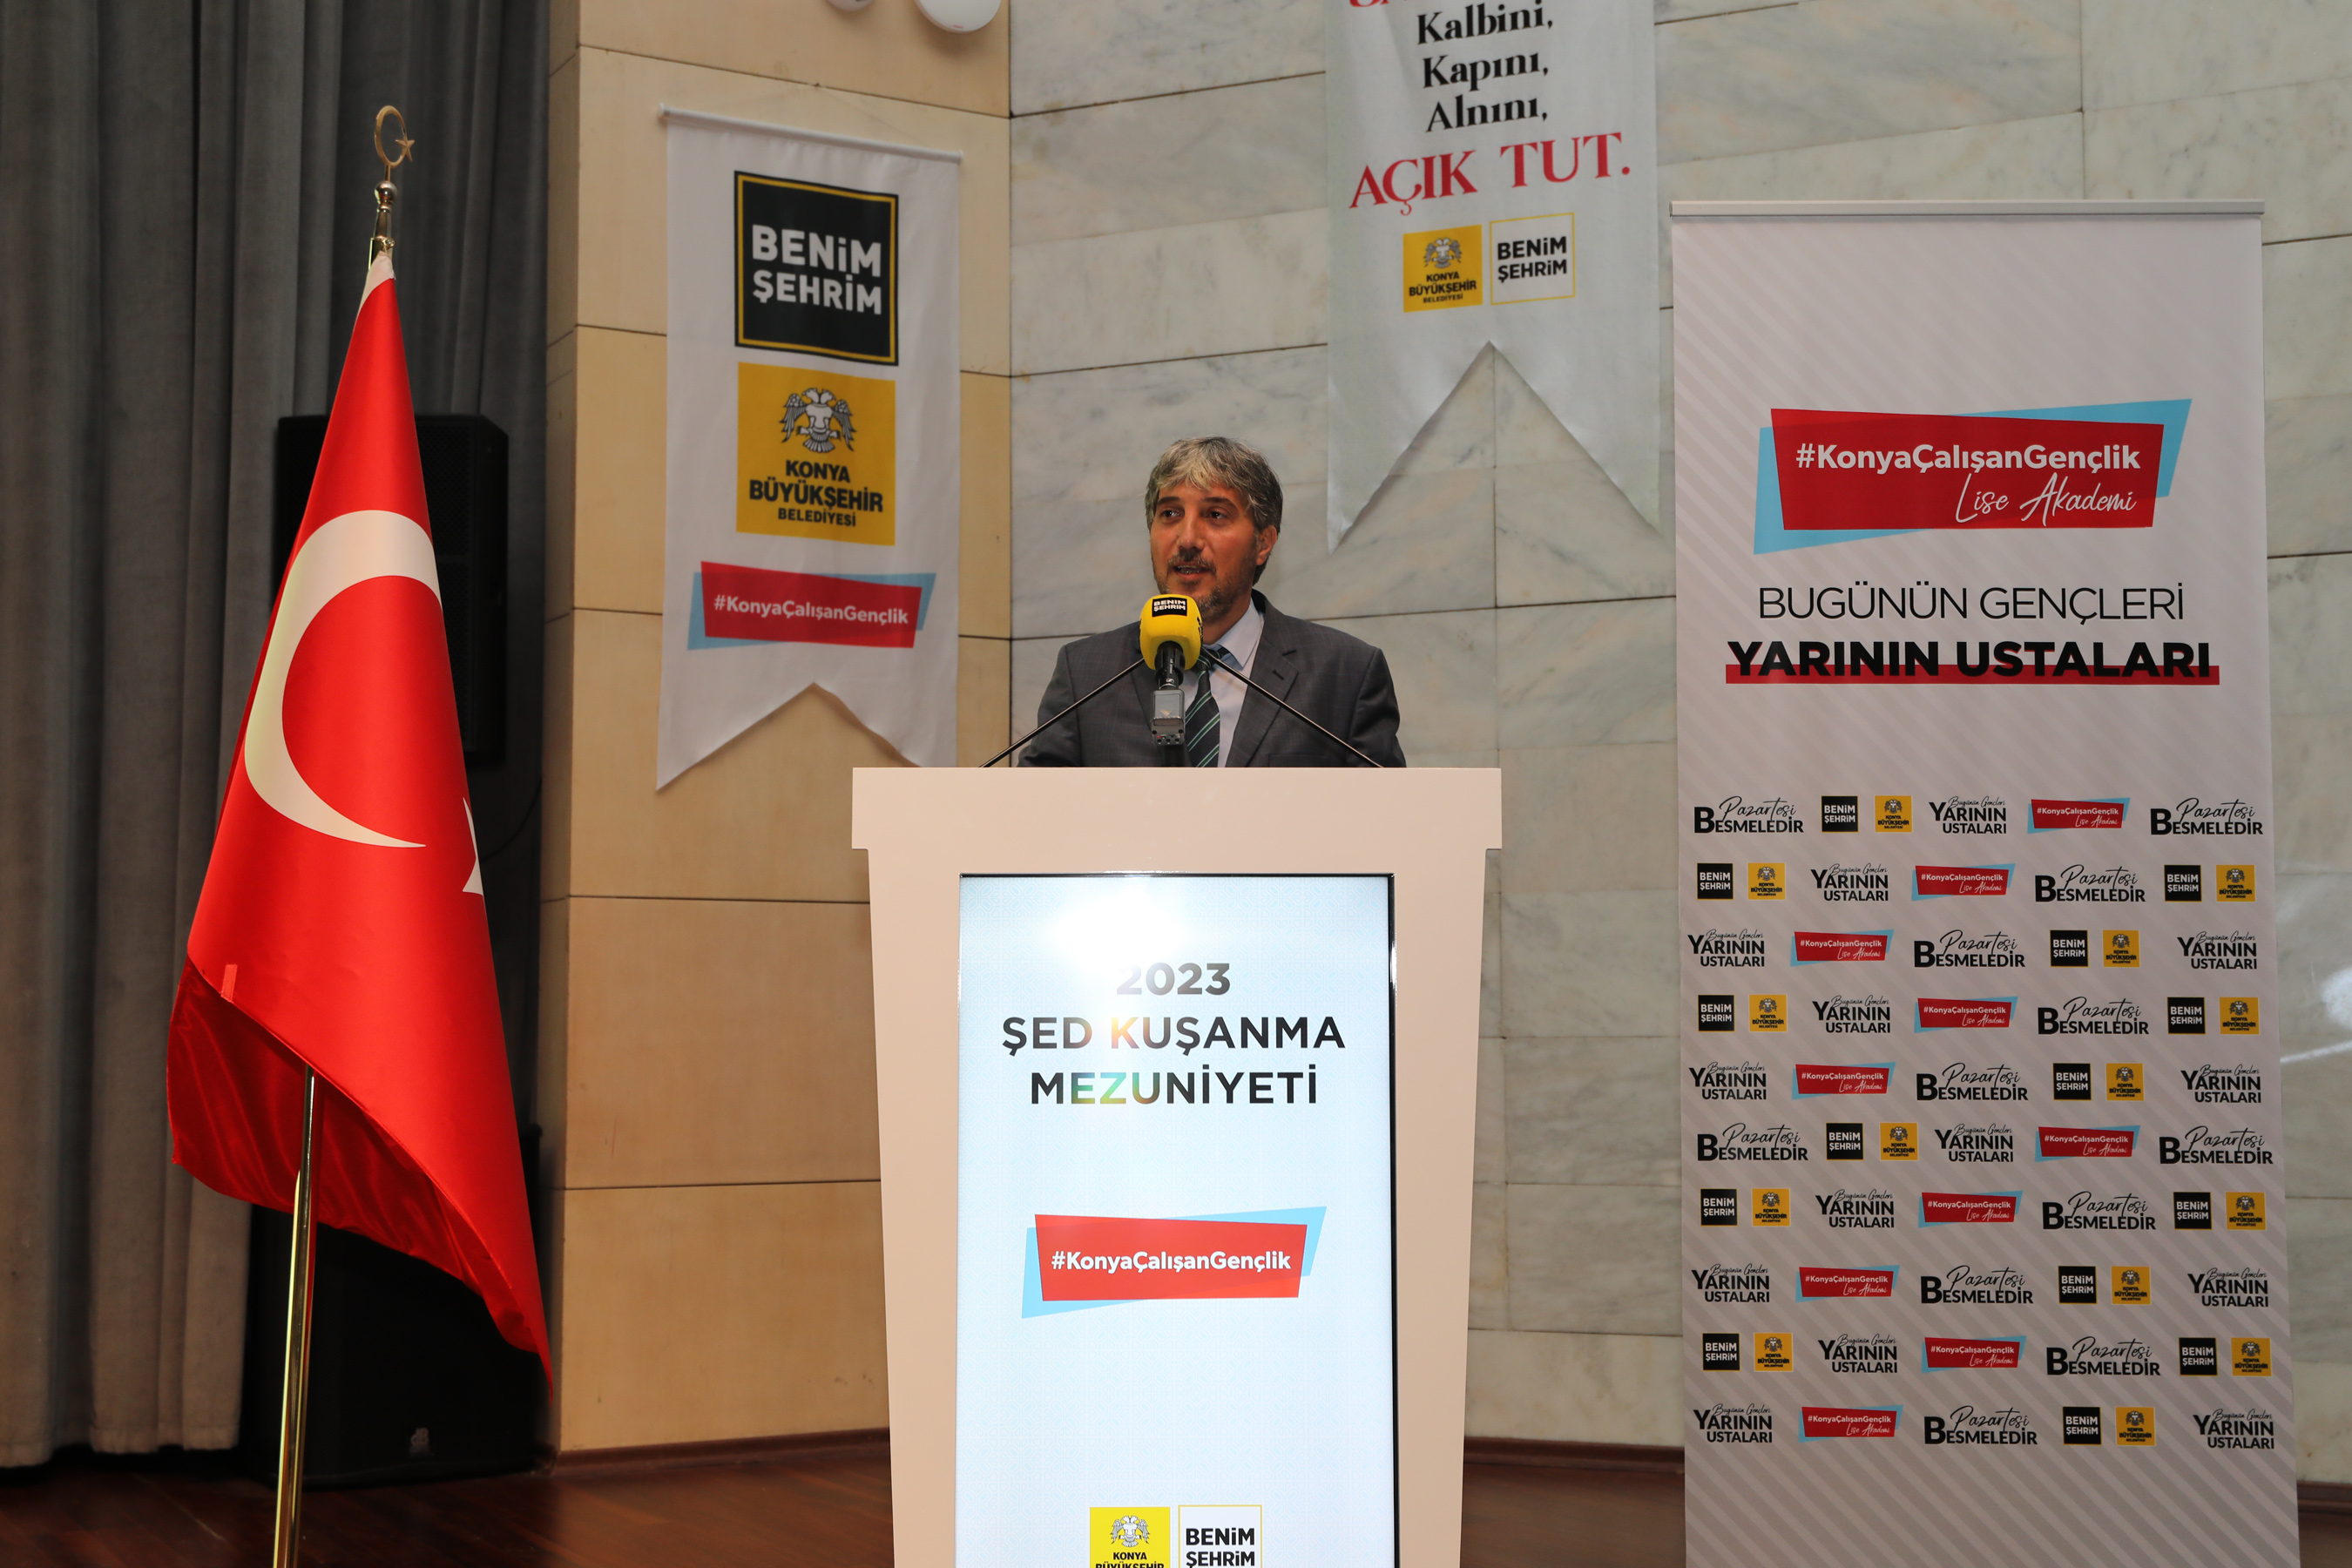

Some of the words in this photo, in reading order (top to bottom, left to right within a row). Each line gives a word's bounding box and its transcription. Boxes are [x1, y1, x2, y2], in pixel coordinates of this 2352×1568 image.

[1416, 0, 1553, 45] Kalbini,
[1423, 52, 1549, 91] Kapını,
[1426, 94, 1548, 132] Alnını,
[1348, 150, 1478, 216] AÇIK
[1499, 132, 1631, 188] TUT.
[1409, 279, 1477, 296] BÜYÜKŞEHİR
[1426, 271, 1460, 282] KONYA
[1795, 443, 2141, 475] #KonyaÇalışanGençlik
[785, 460, 850, 483] KONYA
[749, 476, 883, 512] BÜYÜKŞEHİR
[1955, 473, 2010, 524] Lise
[2019, 473, 2138, 526] Akademi
[778, 507, 856, 527] BELEDİYESİ
[713, 595, 909, 626] #KonyaÇalışanGençlik
[1760, 581, 1968, 619] BUGÜNÜN
[1980, 582, 2184, 626] GENÇLERİ
[1727, 641, 1940, 678] YARININ
[1957, 641, 2211, 679] USTALARI
[1694, 807, 1803, 833] BESMELEDİR
[1720, 796, 1795, 821] Pazartesi
[1930, 803, 2006, 821] YARININ
[2176, 798, 2254, 822] Pazartesi
[1943, 823, 2006, 834] USTALARI
[2151, 808, 2262, 835] BESMELEDİR
[1811, 871, 1888, 889] YARININ
[2035, 875, 2146, 902] BESMELEDİR
[2060, 865, 2138, 889] Pazartesi
[1824, 891, 1888, 901] USTALARI
[1688, 936, 1764, 954] YARININ
[1915, 940, 2024, 967] BESMELEDİR
[1940, 929, 2017, 955] Pazartesi
[2177, 938, 2256, 956] YARININ
[1701, 956, 1764, 966] USTALARI
[2190, 958, 2256, 969] USTALARI
[1116, 963, 1231, 996] 2023
[1813, 1002, 1890, 1020] YARININ
[2038, 1007, 2149, 1034] BESMELEDİR
[2064, 997, 2141, 1022] Pazartesi
[1002, 1016, 1092, 1057] ŞED
[1111, 1016, 1346, 1057] KUŞANMA
[1826, 1022, 1890, 1032] USTALARI
[1031, 1064, 1318, 1105] MEZUNİYETİ
[1689, 1069, 1766, 1087] YARININ
[1916, 1073, 2028, 1100] BESMELEDİR
[1942, 1063, 2020, 1088] Pazartesi
[2181, 1071, 2261, 1090] YARININ
[1702, 1089, 1766, 1099] USTALARI
[2194, 1092, 2261, 1103] USTALARI
[1698, 1133, 1808, 1160] BESMELEDİR
[1723, 1123, 1800, 1148] Pazartesi
[1935, 1130, 2013, 1149] YARININ
[2186, 1126, 2265, 1152] Pazartesi
[1948, 1151, 2013, 1162] USTALARI
[2159, 1137, 2273, 1164] BESMELEDİR
[1815, 1195, 1894, 1214] YARININ
[2043, 1202, 2156, 1229] BESMELEDİR
[2069, 1192, 2148, 1217] Pazartesi
[1828, 1216, 1894, 1227] USTALARI
[1051, 1250, 1292, 1274] #KonyaÇalışanGençlik
[1692, 1270, 1769, 1289] YARININ
[1921, 1276, 2033, 1303] BESMELEDİR
[1947, 1266, 2025, 1291] Pazartesi
[2187, 1274, 2268, 1294] YARININ
[1705, 1291, 1769, 1302] USTALARI
[2201, 1295, 2268, 1307] USTALARI
[1818, 1340, 1897, 1360] YARININ
[2072, 1336, 2153, 1362] Pazartesi
[1831, 1362, 1897, 1373] USTALARI
[2046, 1348, 2160, 1375] BESMELEDİR
[1693, 1409, 1772, 1429] YARININ
[1924, 1416, 2038, 1444] BESMELEDİR
[1950, 1406, 2030, 1431] Pazartesi
[2193, 1415, 2274, 1436] YARININ
[1707, 1431, 1772, 1443] USTALARI
[2207, 1437, 2274, 1449] USTALARI
[1112, 1551, 1147, 1560] KONYA
